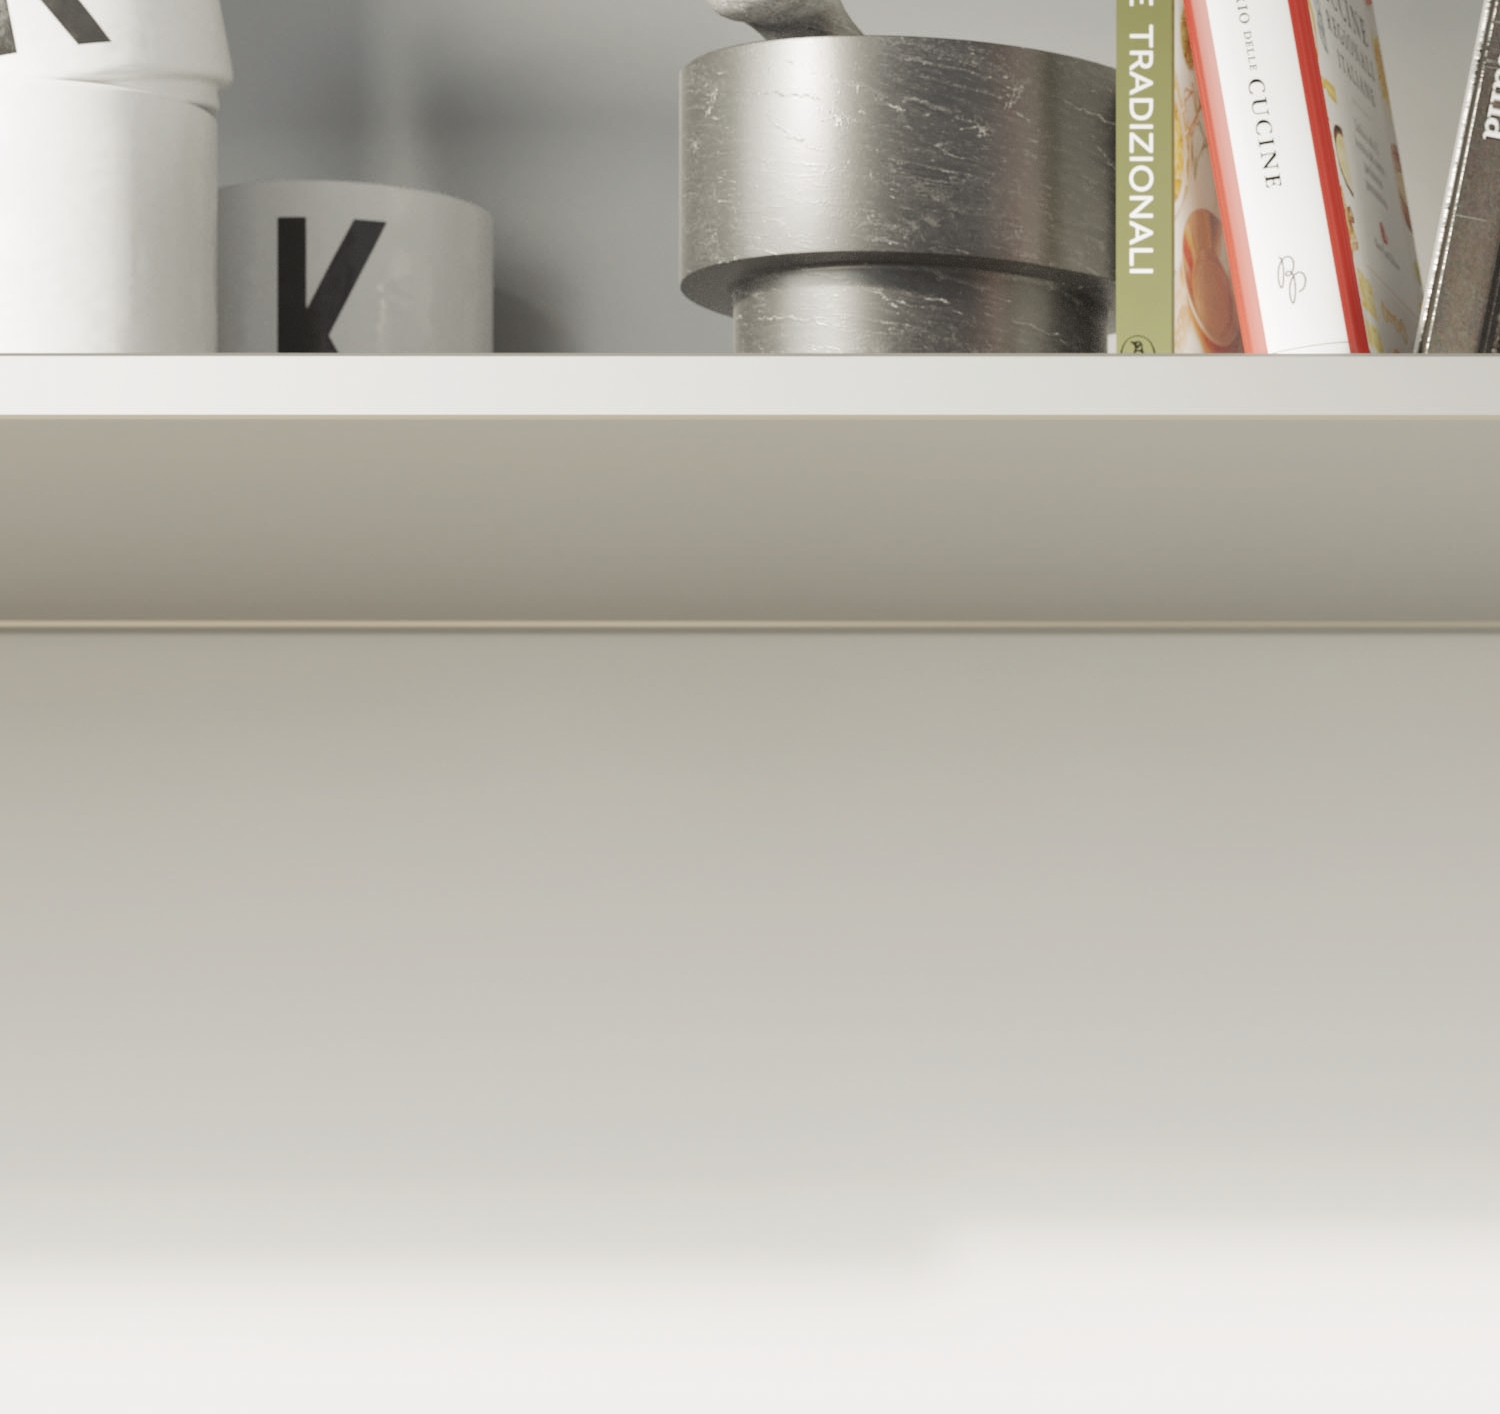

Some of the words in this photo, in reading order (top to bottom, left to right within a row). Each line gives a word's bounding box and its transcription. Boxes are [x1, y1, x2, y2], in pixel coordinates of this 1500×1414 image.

[1243, 31, 1258, 71] DELLE
[1129, 24, 1154, 275] TRADIZIONALI
[1248, 79, 1282, 189] CUCINE
